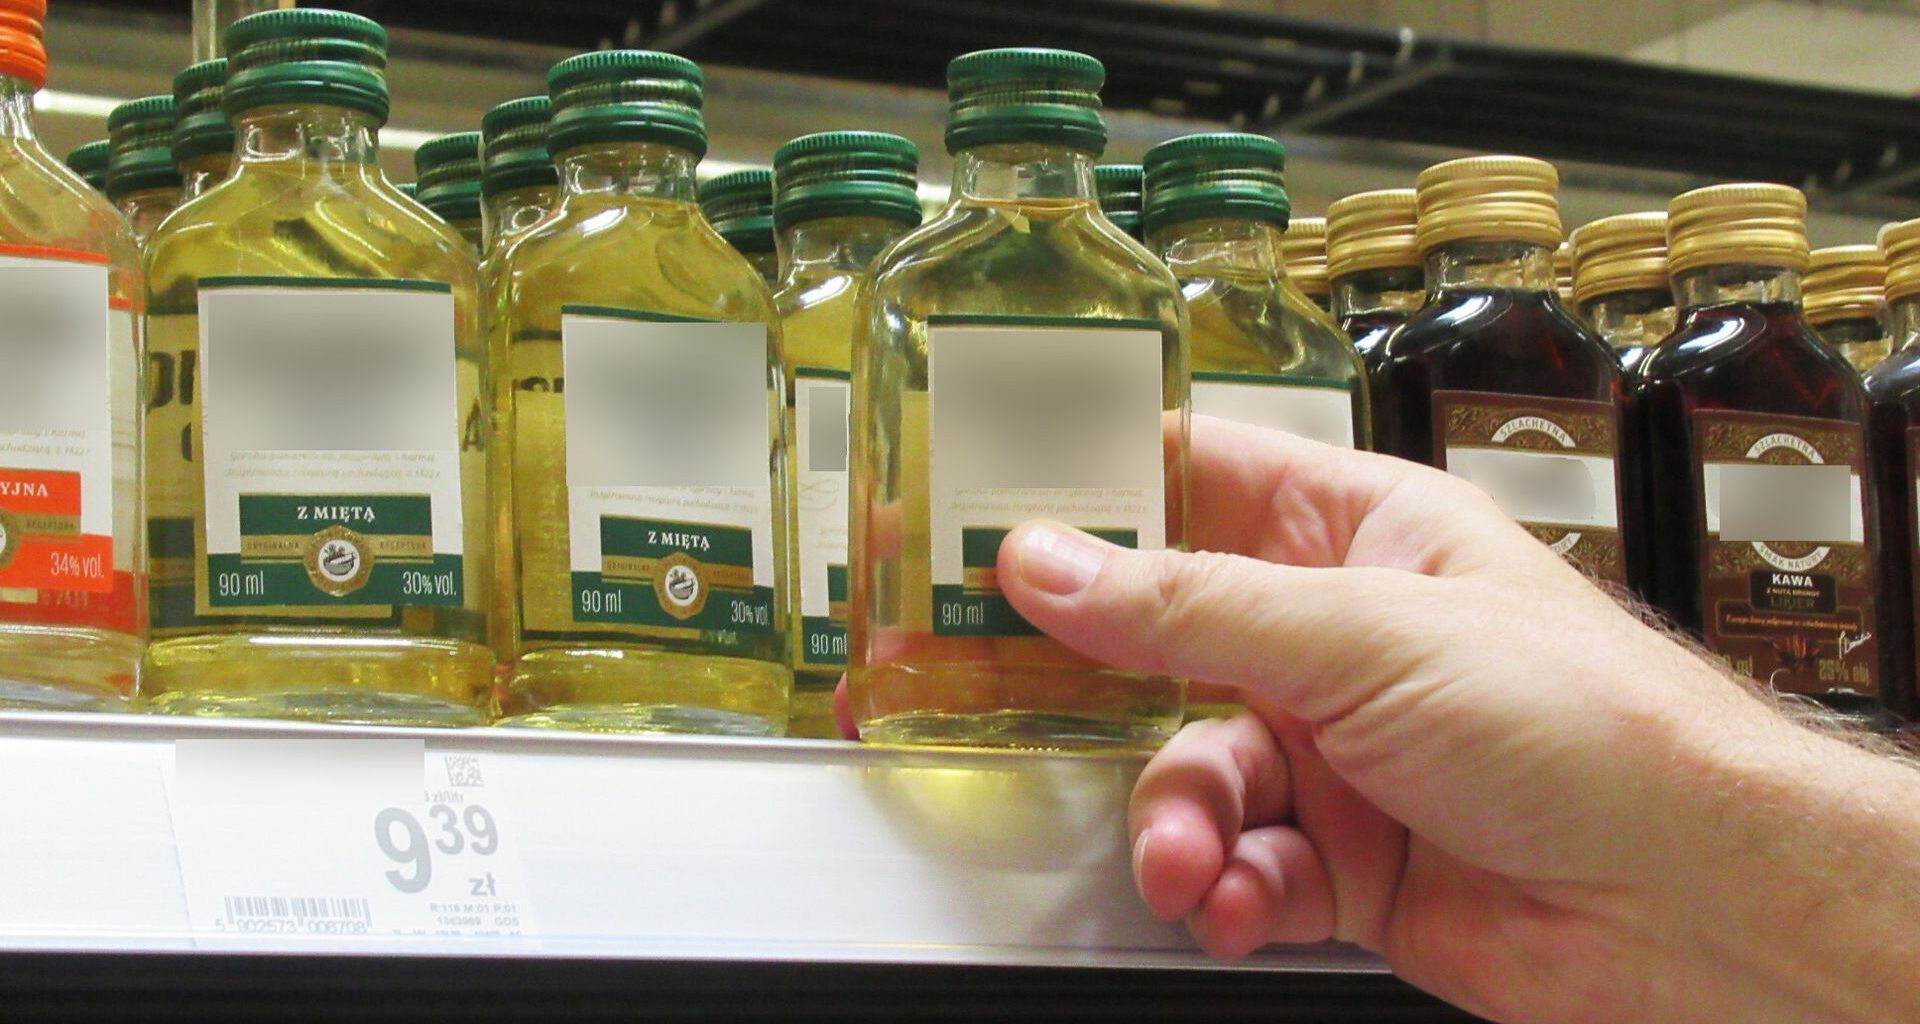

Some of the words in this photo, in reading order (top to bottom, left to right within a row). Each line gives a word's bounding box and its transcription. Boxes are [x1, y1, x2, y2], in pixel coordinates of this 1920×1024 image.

[1500, 418, 1566, 441] SZLACHETNA
[297, 506, 308, 520] Z
[313, 506, 376, 523] MIĘTĄ
[648, 531, 657, 544] Z
[661, 533, 711, 551] MIĘTĄ
[50, 552, 80, 577] 34%
[83, 554, 105, 579] vol.
[219, 573, 240, 597] 90
[246, 571, 264, 595] ml
[402, 571, 432, 595] 30%
[434, 571, 457, 597] vol.
[1772, 573, 1813, 588] KAWA
[582, 590, 601, 613] 90
[606, 589, 622, 613] ml
[731, 600, 754, 624] 30%
[943, 603, 962, 626] 90
[967, 602, 984, 625] ml
[811, 633, 828, 655] 90
[832, 633, 847, 655] ml
[1819, 658, 1850, 682] 25%
[468, 872, 497, 897] zł
[236, 919, 297, 933] 902573
